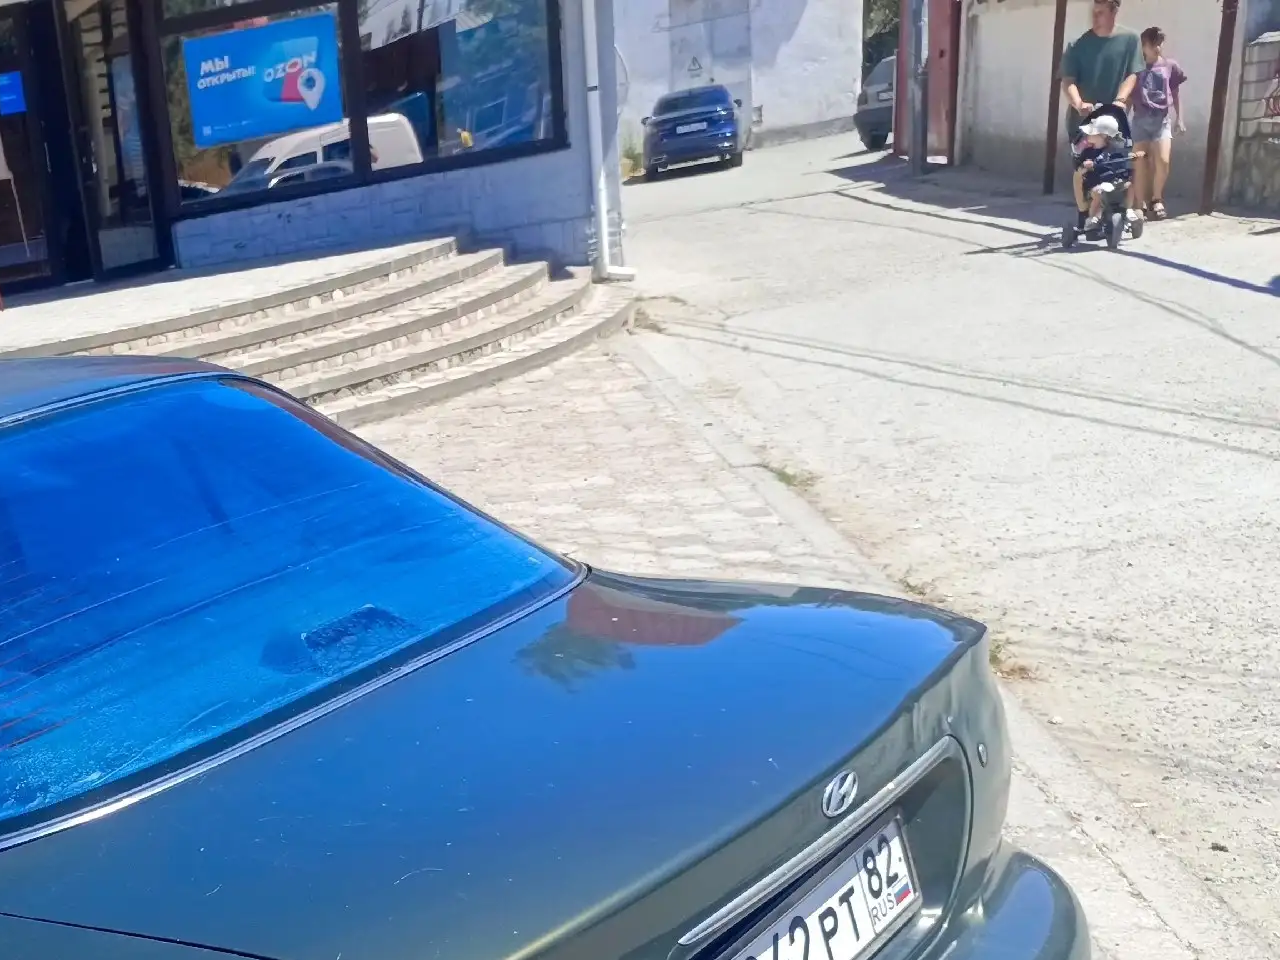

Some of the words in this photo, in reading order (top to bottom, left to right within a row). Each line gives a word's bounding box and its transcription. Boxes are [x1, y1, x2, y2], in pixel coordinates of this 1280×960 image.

[200, 55, 230, 76] МЫ
[263, 51, 317, 83] OZON
[862, 833, 899, 900] 82
[871, 892, 895, 926] RUS
